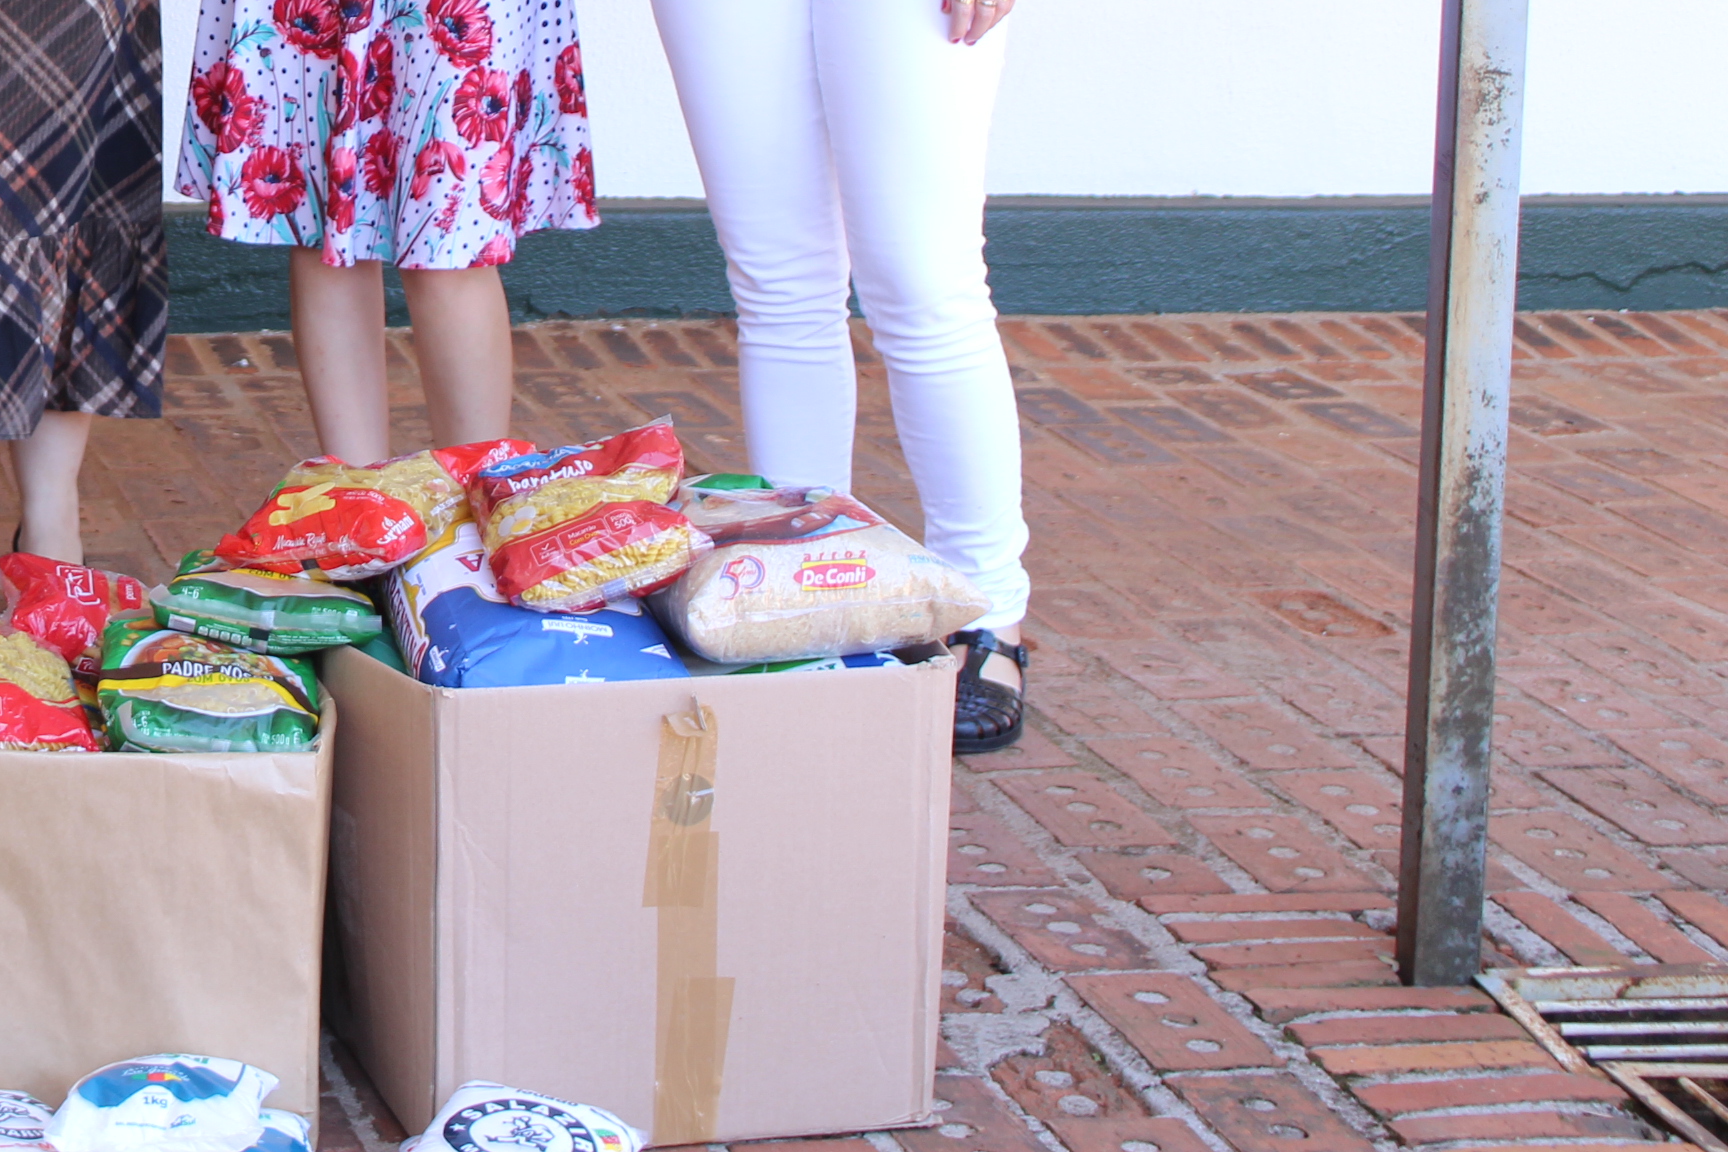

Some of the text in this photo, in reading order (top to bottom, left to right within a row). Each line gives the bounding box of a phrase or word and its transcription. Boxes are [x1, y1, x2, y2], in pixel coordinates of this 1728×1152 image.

[803, 550, 867, 561] arroz
[802, 567, 867, 585] De Conti
[162, 661, 214, 677] PADRE
[143, 1095, 168, 1109] 1kg
